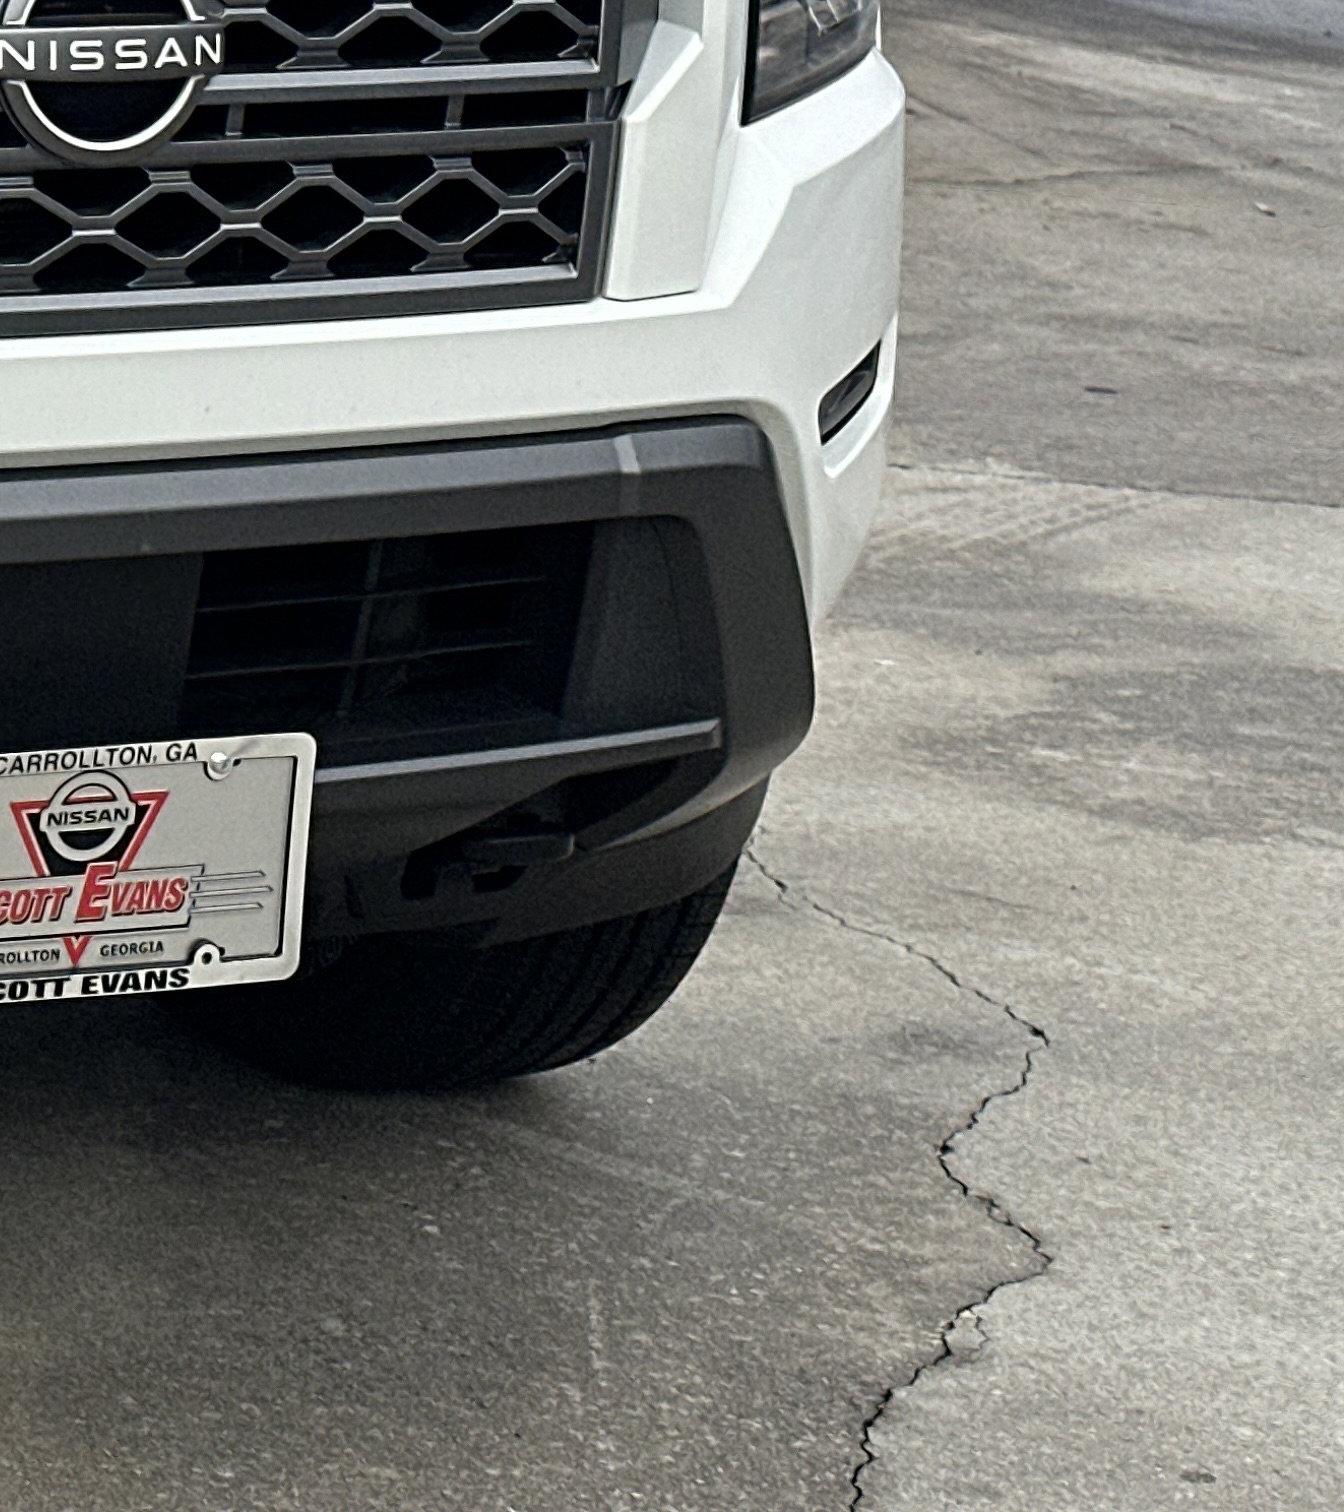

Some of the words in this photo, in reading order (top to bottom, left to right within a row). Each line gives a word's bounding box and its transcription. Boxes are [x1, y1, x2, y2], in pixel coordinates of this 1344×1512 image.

[165, 742, 198, 762] GA
[46, 806, 130, 827] NISSAN
[74, 862, 188, 923] EVANS
[100, 940, 164, 957] GEORGIA
[81, 967, 189, 994] EVANS
